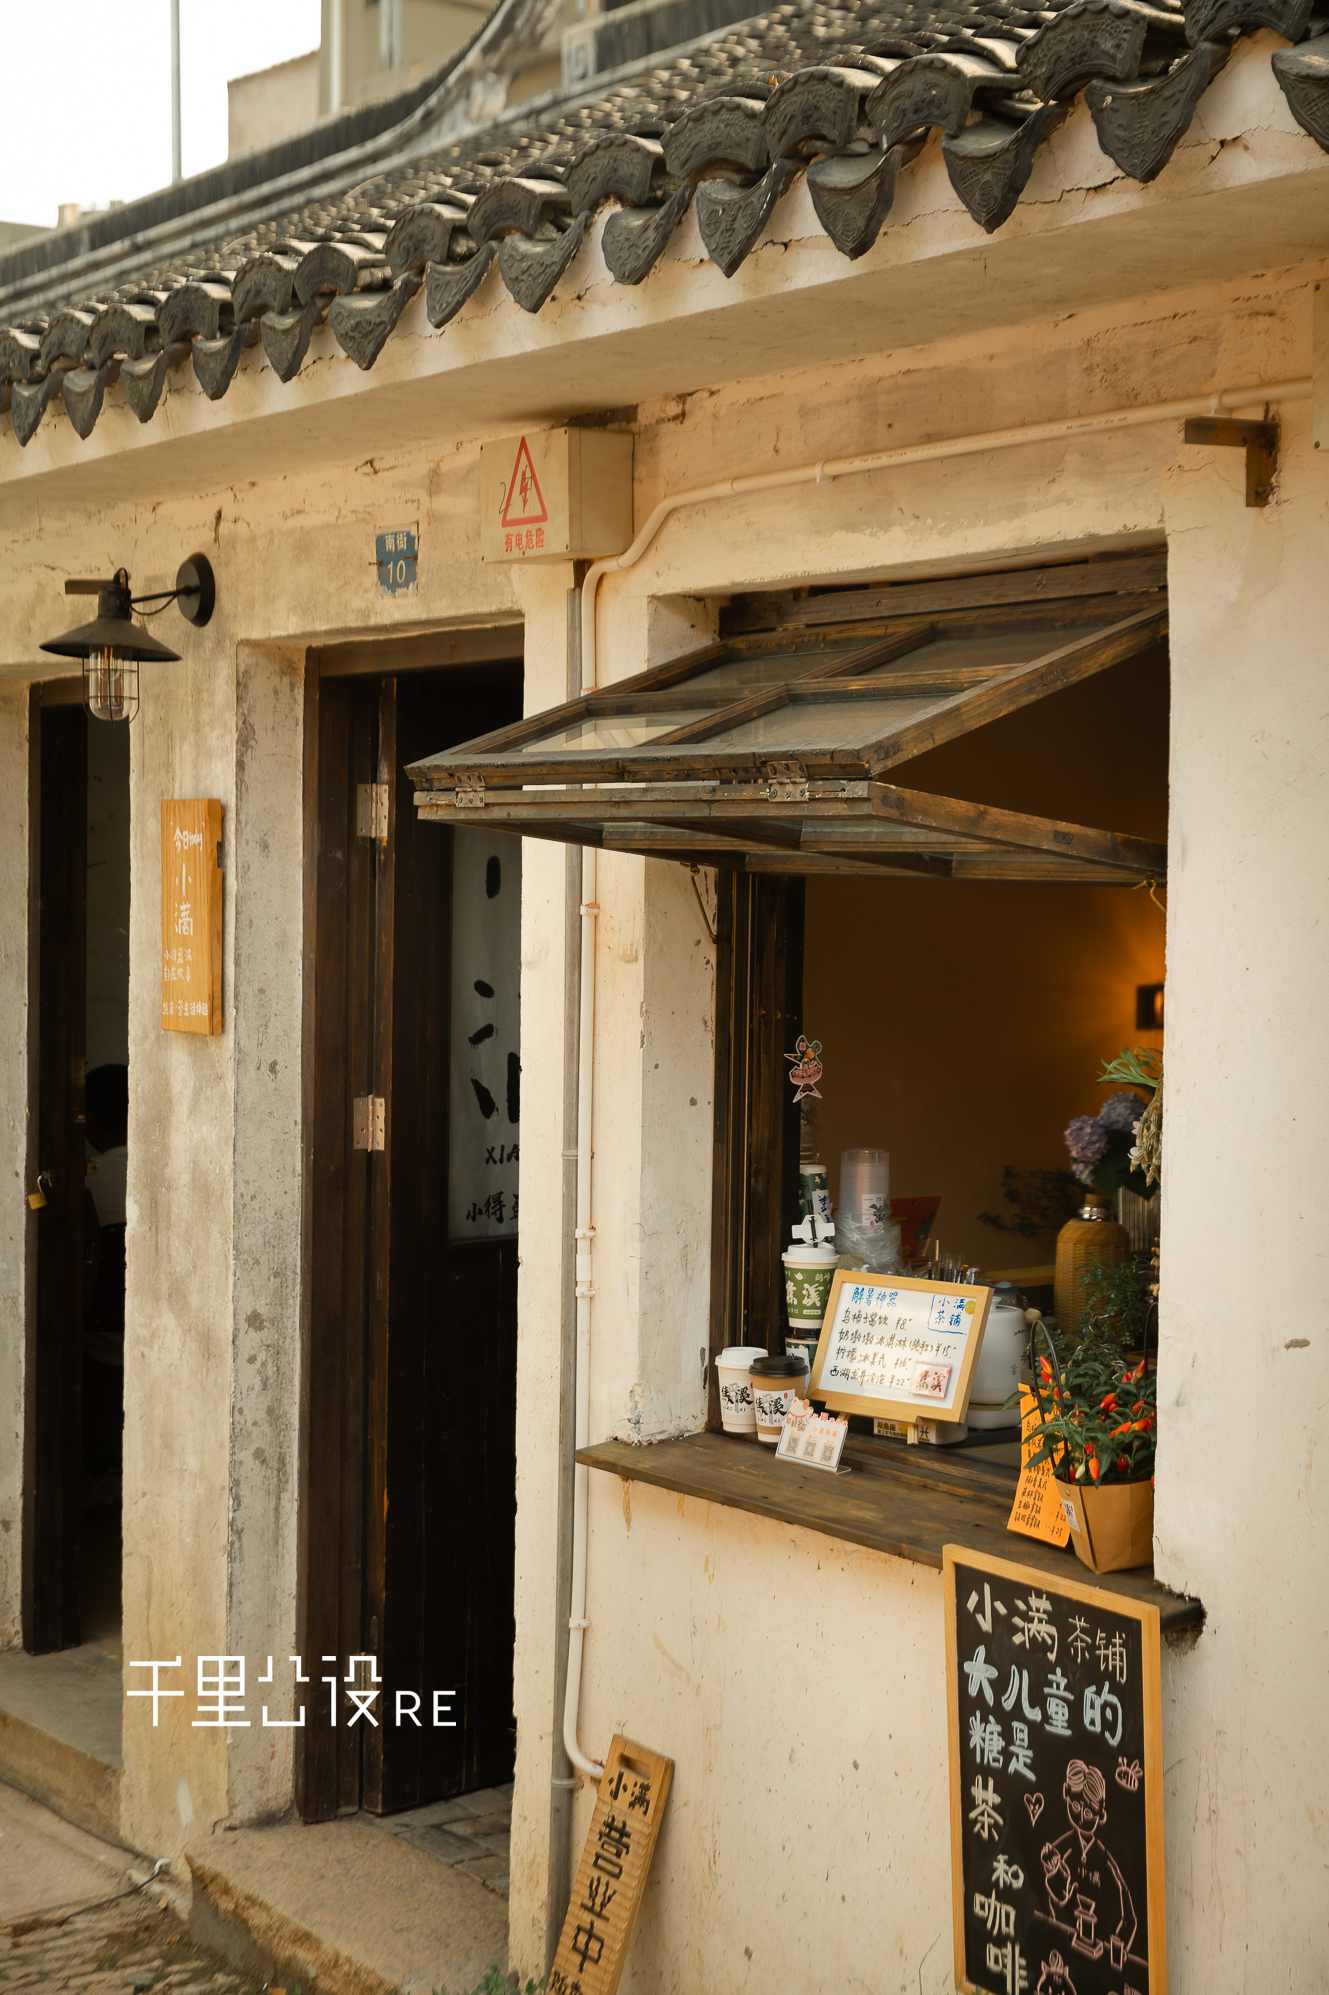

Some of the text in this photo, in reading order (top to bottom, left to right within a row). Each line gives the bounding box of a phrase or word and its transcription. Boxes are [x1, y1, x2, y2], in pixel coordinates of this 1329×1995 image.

[388, 559, 407, 584] 10
[174, 862, 194, 936] 小满
[963, 1644, 1123, 1748] 大儿童的
[968, 1709, 1037, 1783] 糖是
[607, 1770, 652, 1817] 小满
[571, 1813, 632, 1974] 营业中
